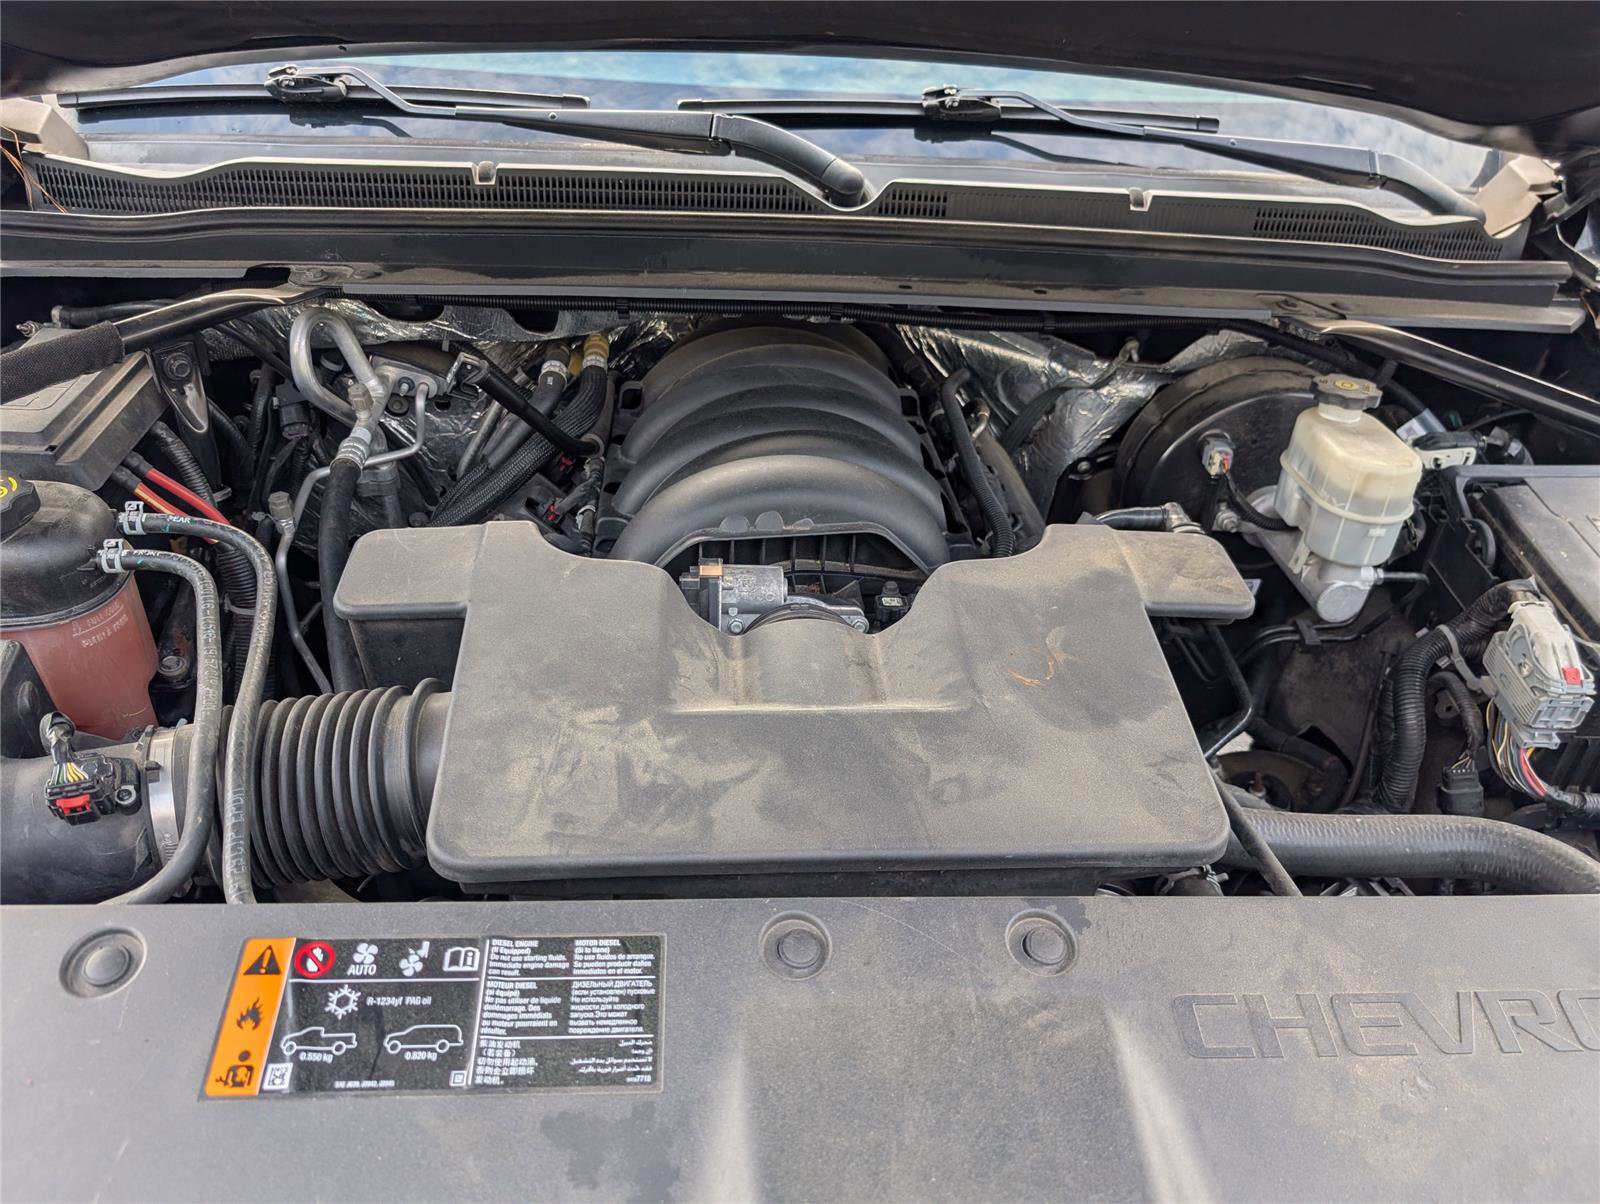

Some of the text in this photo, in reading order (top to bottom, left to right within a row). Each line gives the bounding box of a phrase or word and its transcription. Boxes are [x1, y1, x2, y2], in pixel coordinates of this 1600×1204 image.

[492, 939, 539, 948] DIESEL ENGINE
[347, 964, 377, 976] AUTO
[486, 981, 514, 989] MOTEUR
[405, 997, 421, 1005] PAG
[421, 996, 432, 1005] oil
[323, 1053, 333, 1063] kg
[427, 1052, 438, 1061] kg
